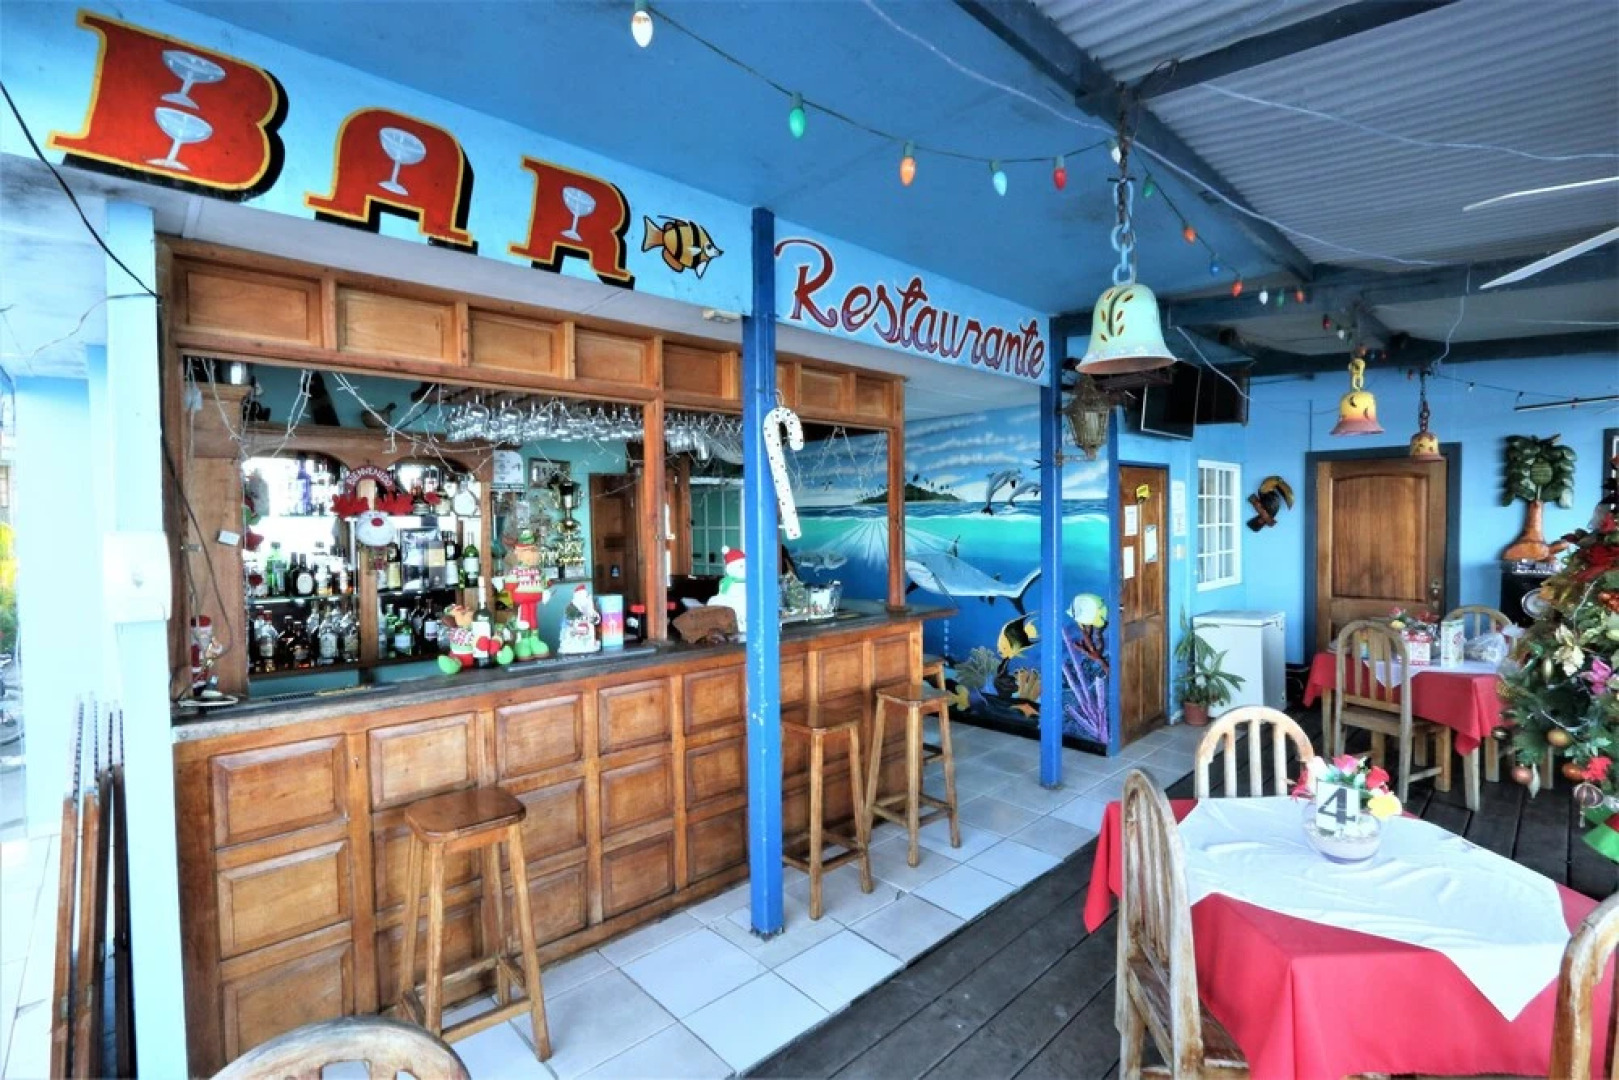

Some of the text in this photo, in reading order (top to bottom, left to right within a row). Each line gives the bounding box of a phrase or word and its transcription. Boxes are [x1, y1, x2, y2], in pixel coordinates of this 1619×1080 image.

[47, 9, 635, 291] BAR
[774, 238, 1045, 380] Restaurante
[1317, 787, 1356, 825] 4
